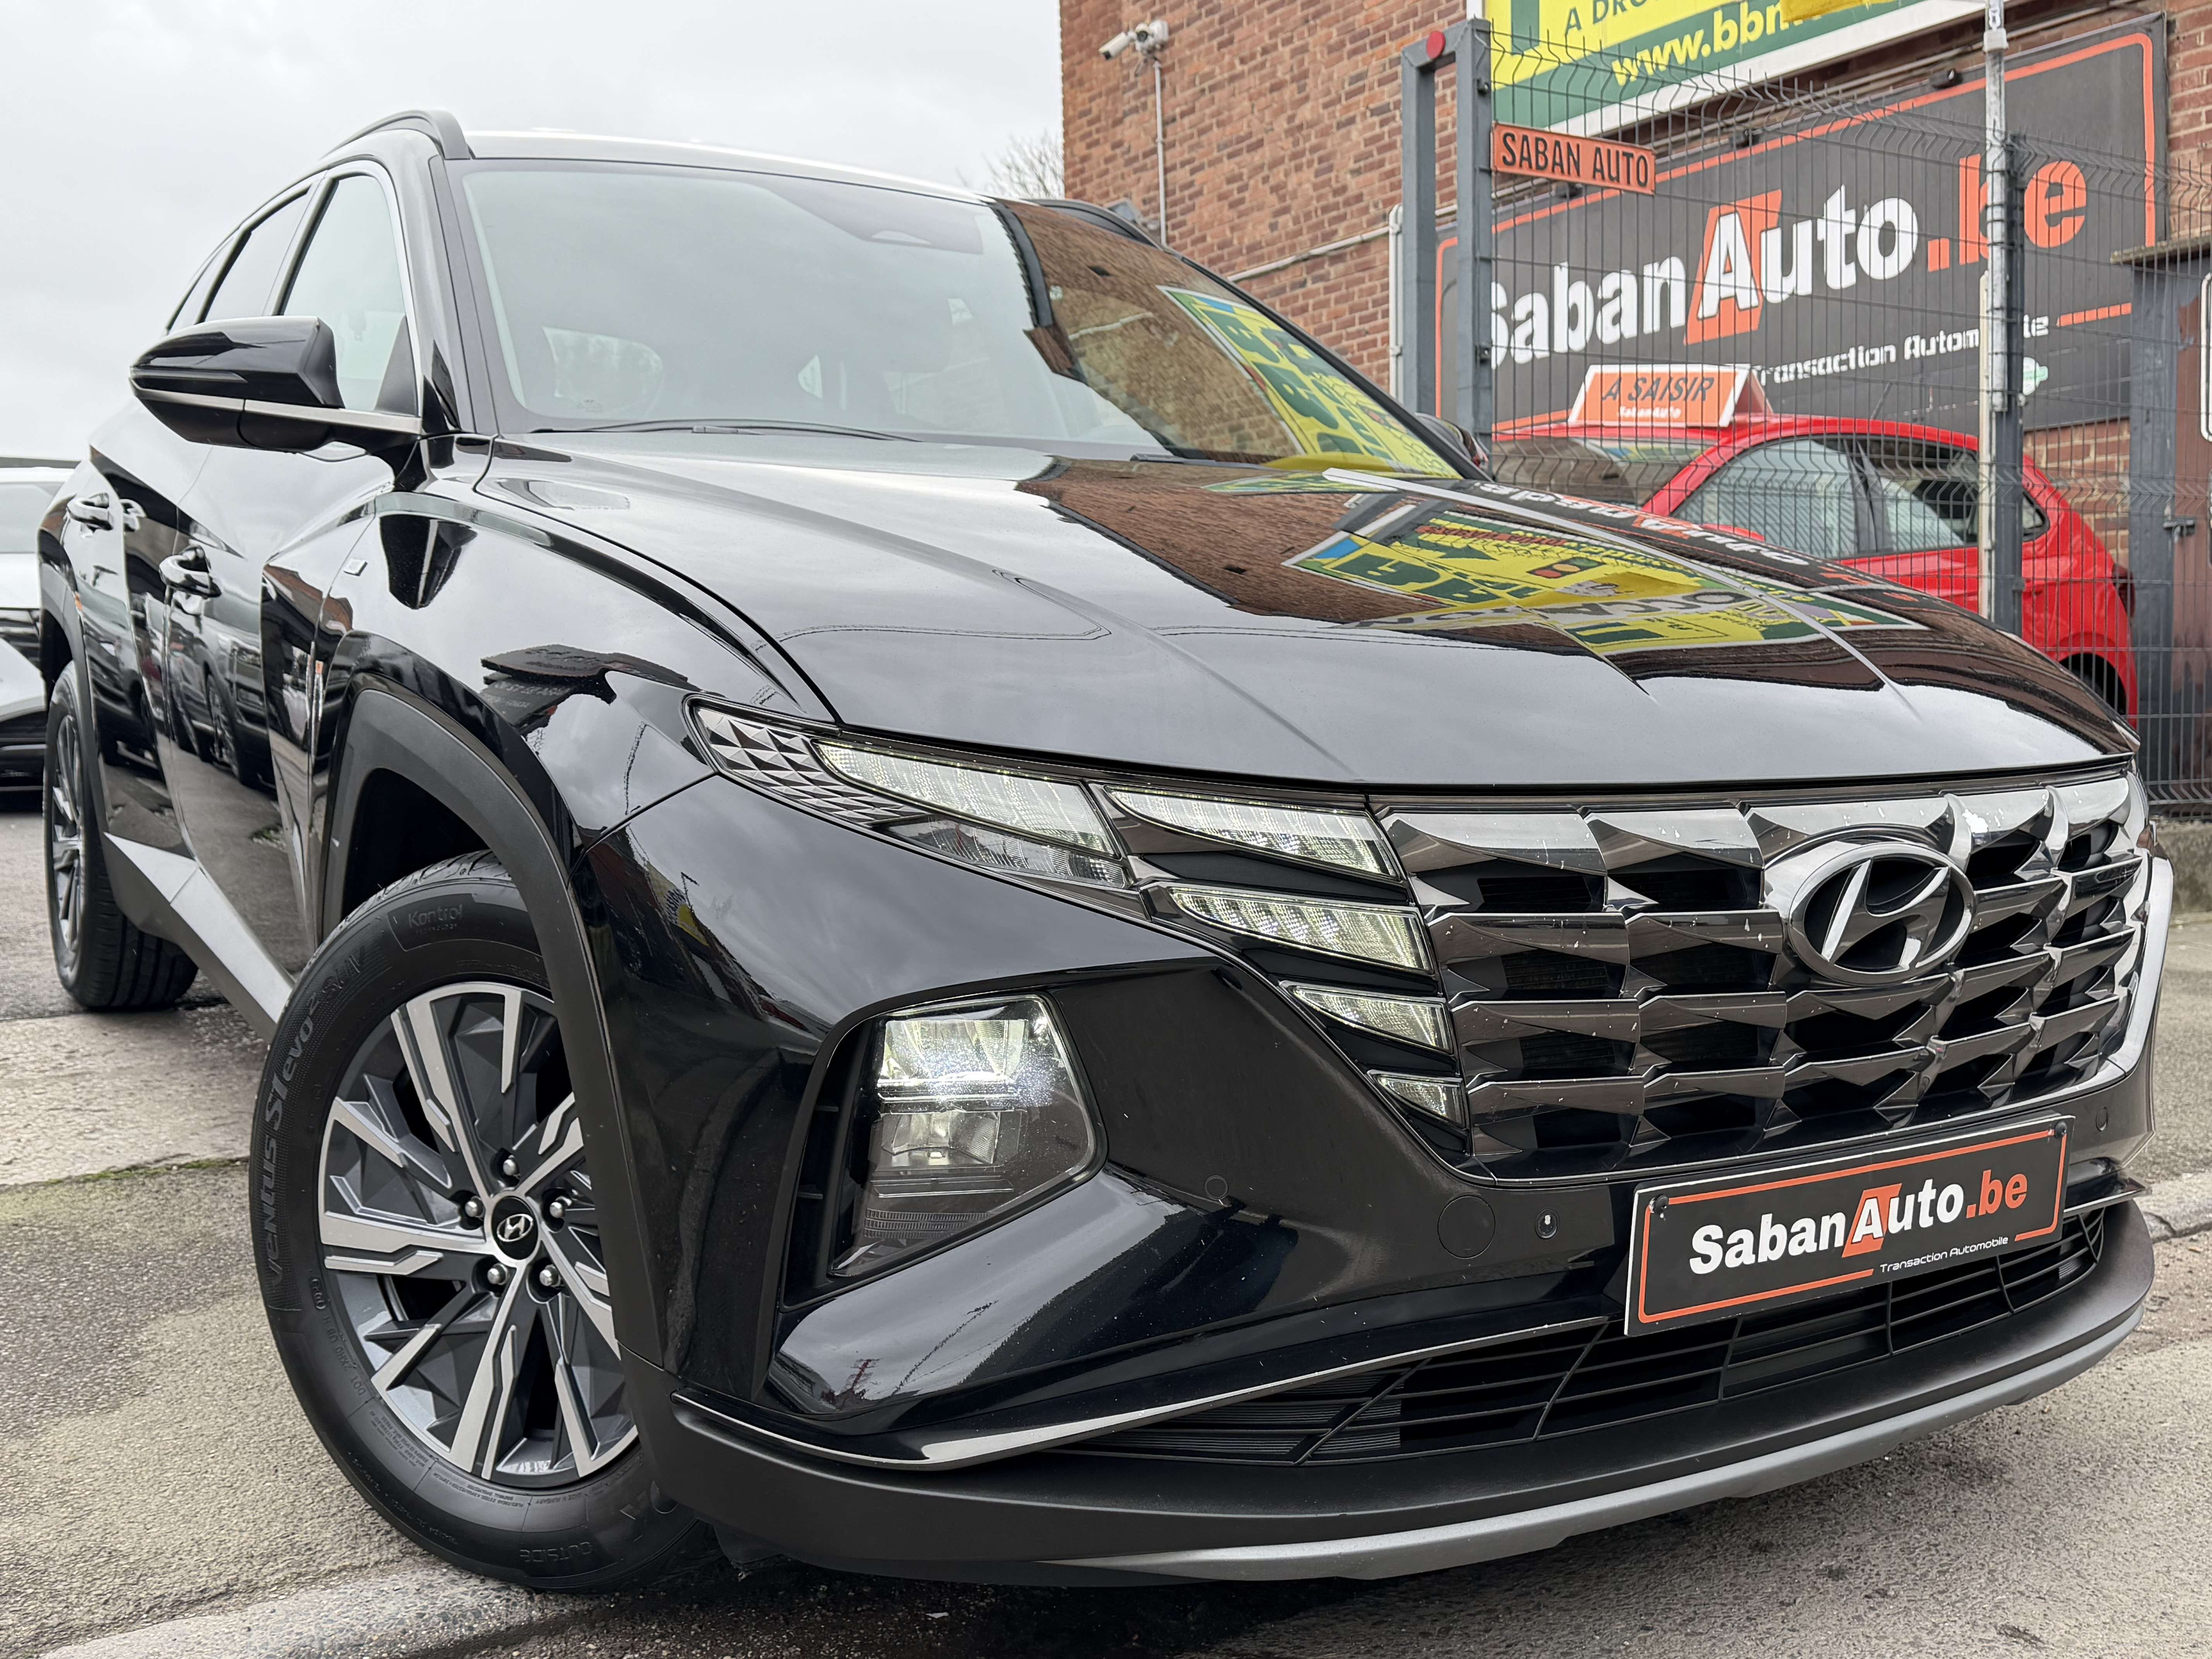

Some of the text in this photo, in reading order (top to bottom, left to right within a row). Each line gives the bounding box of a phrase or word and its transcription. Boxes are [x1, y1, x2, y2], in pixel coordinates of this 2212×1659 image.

[1565, 6, 1582, 35] A
[1502, 133, 1649, 187] SABAN AUTO
[1752, 314, 2049, 386] Transaction Automle
[1602, 377, 1715, 402] A SAISIR
[1689, 1169, 2028, 1274] SabanAuto.be
[1880, 1235, 2008, 1273] Transaction Automobile
